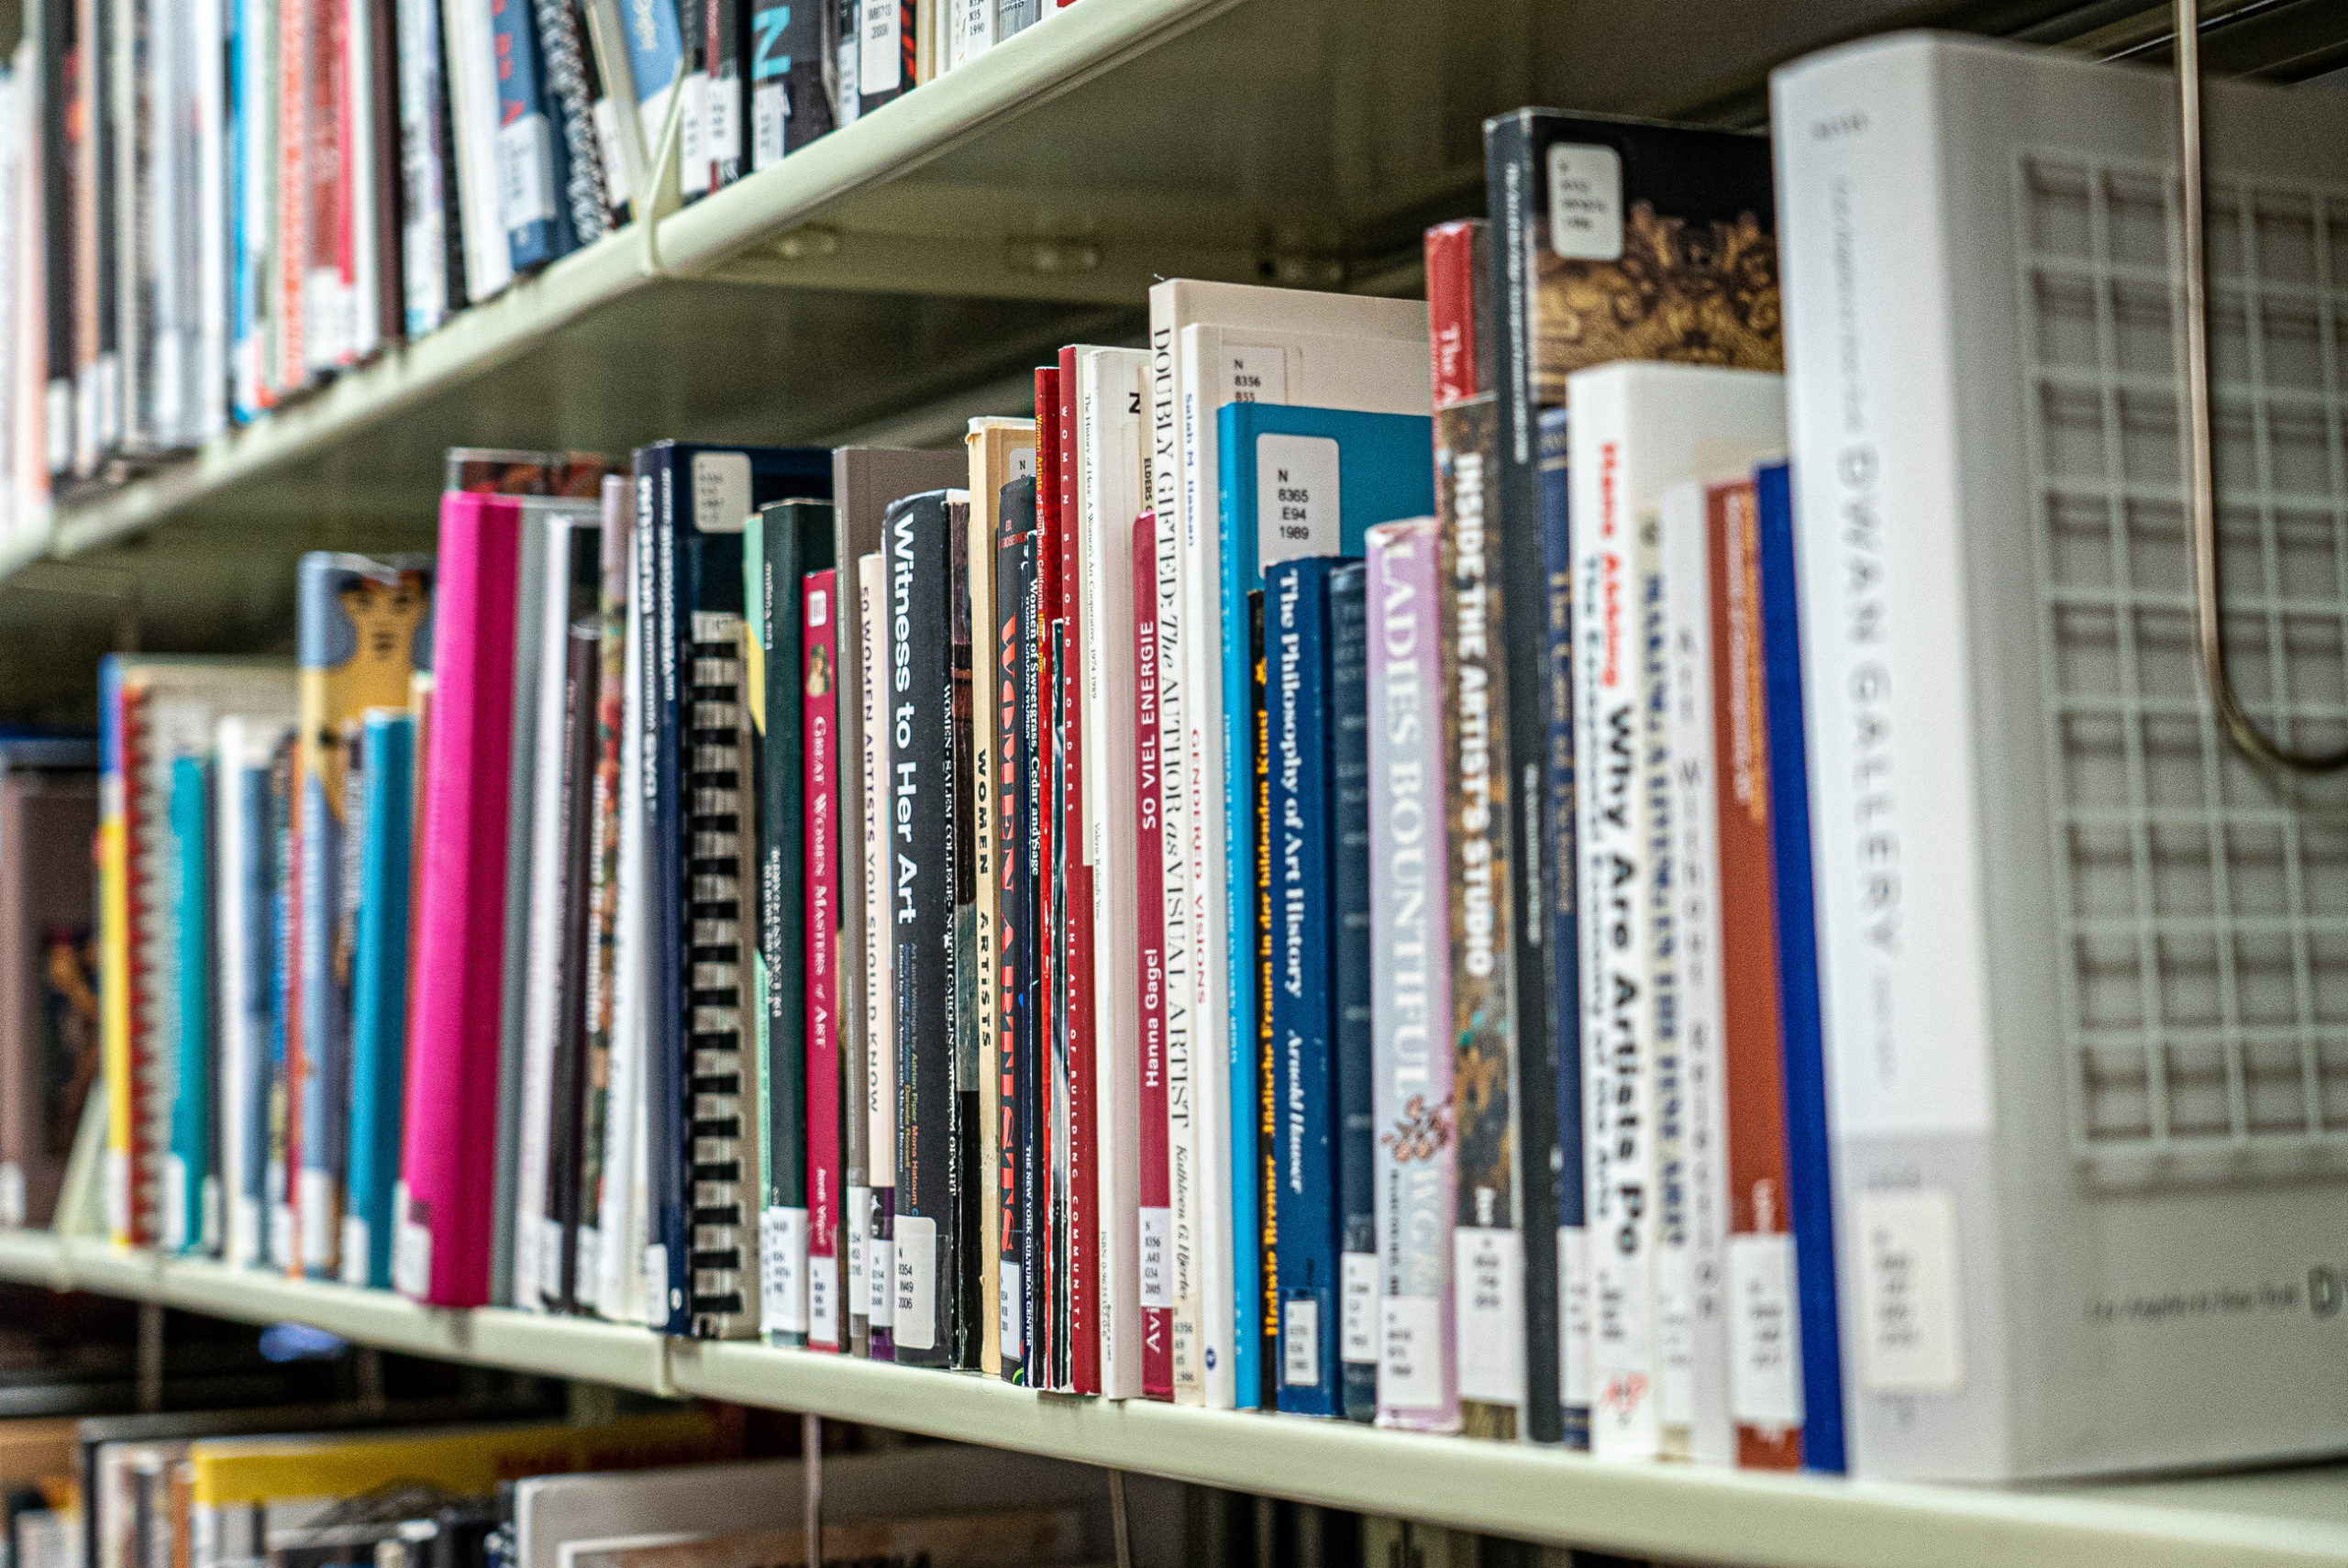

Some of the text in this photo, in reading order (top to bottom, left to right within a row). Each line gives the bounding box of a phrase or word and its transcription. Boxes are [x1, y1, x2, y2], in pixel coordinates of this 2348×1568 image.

[1235, 360, 1244, 370] N
[1235, 376, 1261, 387] 8356
[1019, 460, 1026, 469] N
[1037, 494, 1043, 504] of
[1144, 458, 1152, 502] ELDERS
[1278, 470, 1288, 482] N
[1279, 490, 1309, 502] 8365
[1279, 526, 1309, 540] 1989
[1455, 452, 1485, 580] INSIDE
[1036, 559, 1045, 610] California
[1457, 584, 1487, 658] THE
[863, 619, 875, 723] WOMEN
[894, 512, 918, 925] Witness to Her Art
[944, 684, 952, 749] WOMEN
[1029, 577, 1041, 877] Women of Sweetgrass, Cedar and Sage
[1140, 621, 1157, 830] SO VIEL ENERGIE
[1154, 326, 1190, 1128] DOUBLY GIFTED: The AUTHOR as VISUAL ARTIST
[865, 733, 876, 844] ARTISTS
[944, 760, 953, 818] SALEM
[1279, 568, 1305, 999] The Philosophy of Art History
[1604, 705, 1634, 828] Why
[1382, 543, 1429, 1099] LADIES BOUNTIFUL
[866, 854, 876, 903] YOU
[978, 747, 991, 1048] WOMEN ARTISTS
[1192, 728, 1205, 1004] GENDERED VISIONS
[1611, 855, 1638, 951] Are
[1001, 611, 1015, 1253] WOMEN ARTISTS
[1463, 839, 1494, 977] STUDIO
[947, 973, 956, 1056] CAROLINA
[1070, 1029, 1077, 1054] OF
[1145, 948, 1162, 1088] Hanna Gagel
[869, 1032, 879, 1113] KNOW
[911, 1125, 919, 1157] Mona
[911, 1160, 919, 1206] Hatoum
[898, 1247, 903, 1259] N
[898, 1264, 913, 1276] 8354
[1072, 1195, 1080, 1331] COMMUNITY
[898, 1297, 914, 1309] 2006
